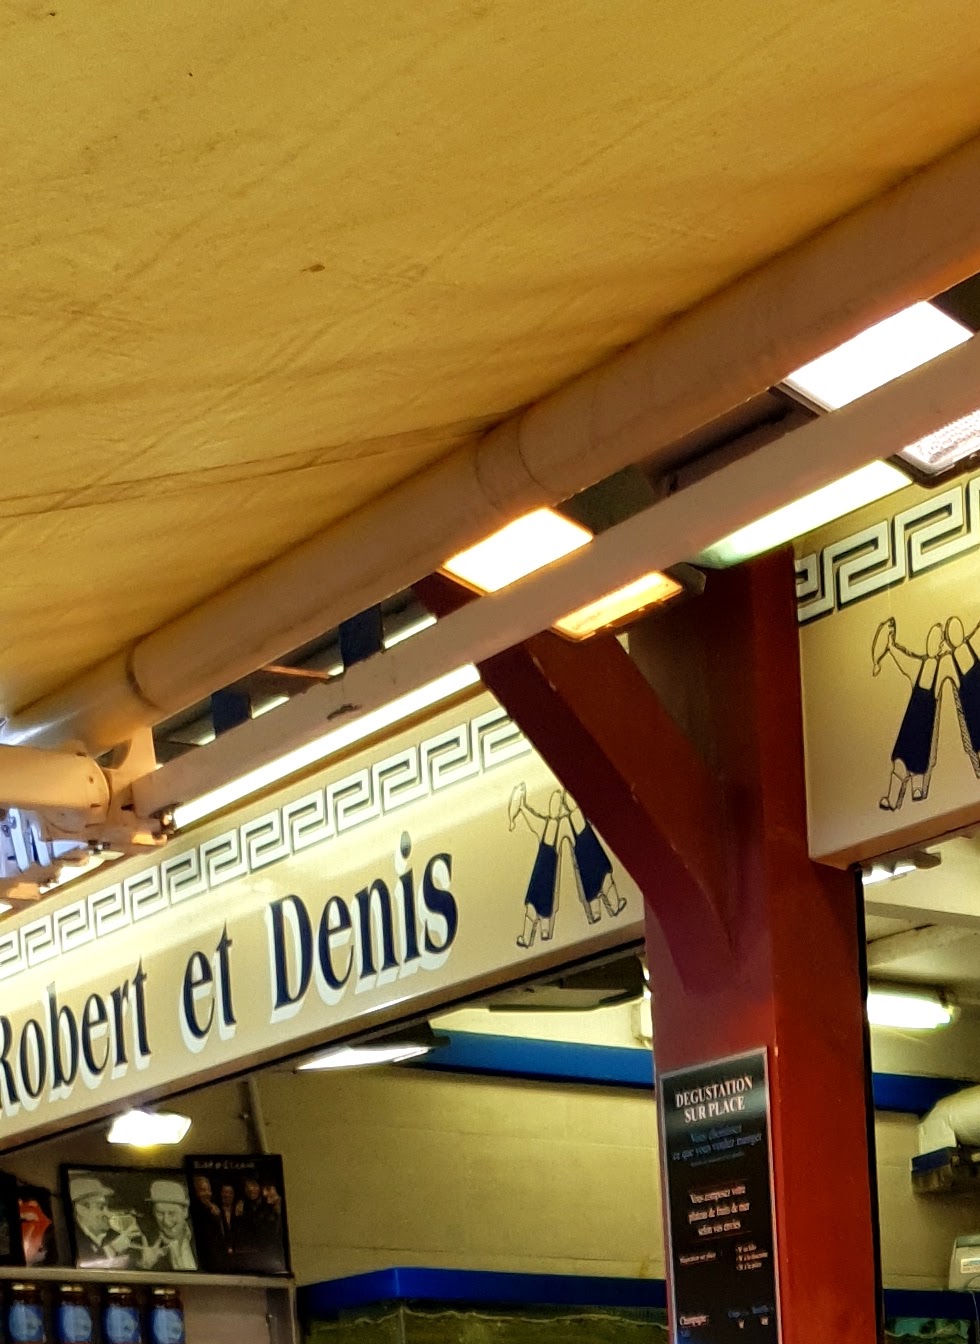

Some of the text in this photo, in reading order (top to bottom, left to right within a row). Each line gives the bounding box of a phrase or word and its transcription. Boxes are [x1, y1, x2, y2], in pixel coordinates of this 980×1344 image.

[182, 921, 237, 1048] et
[267, 831, 459, 1018] Denis
[675, 1075, 753, 1108] DEGUSTATION
[684, 1095, 746, 1124] SUR PLACE
